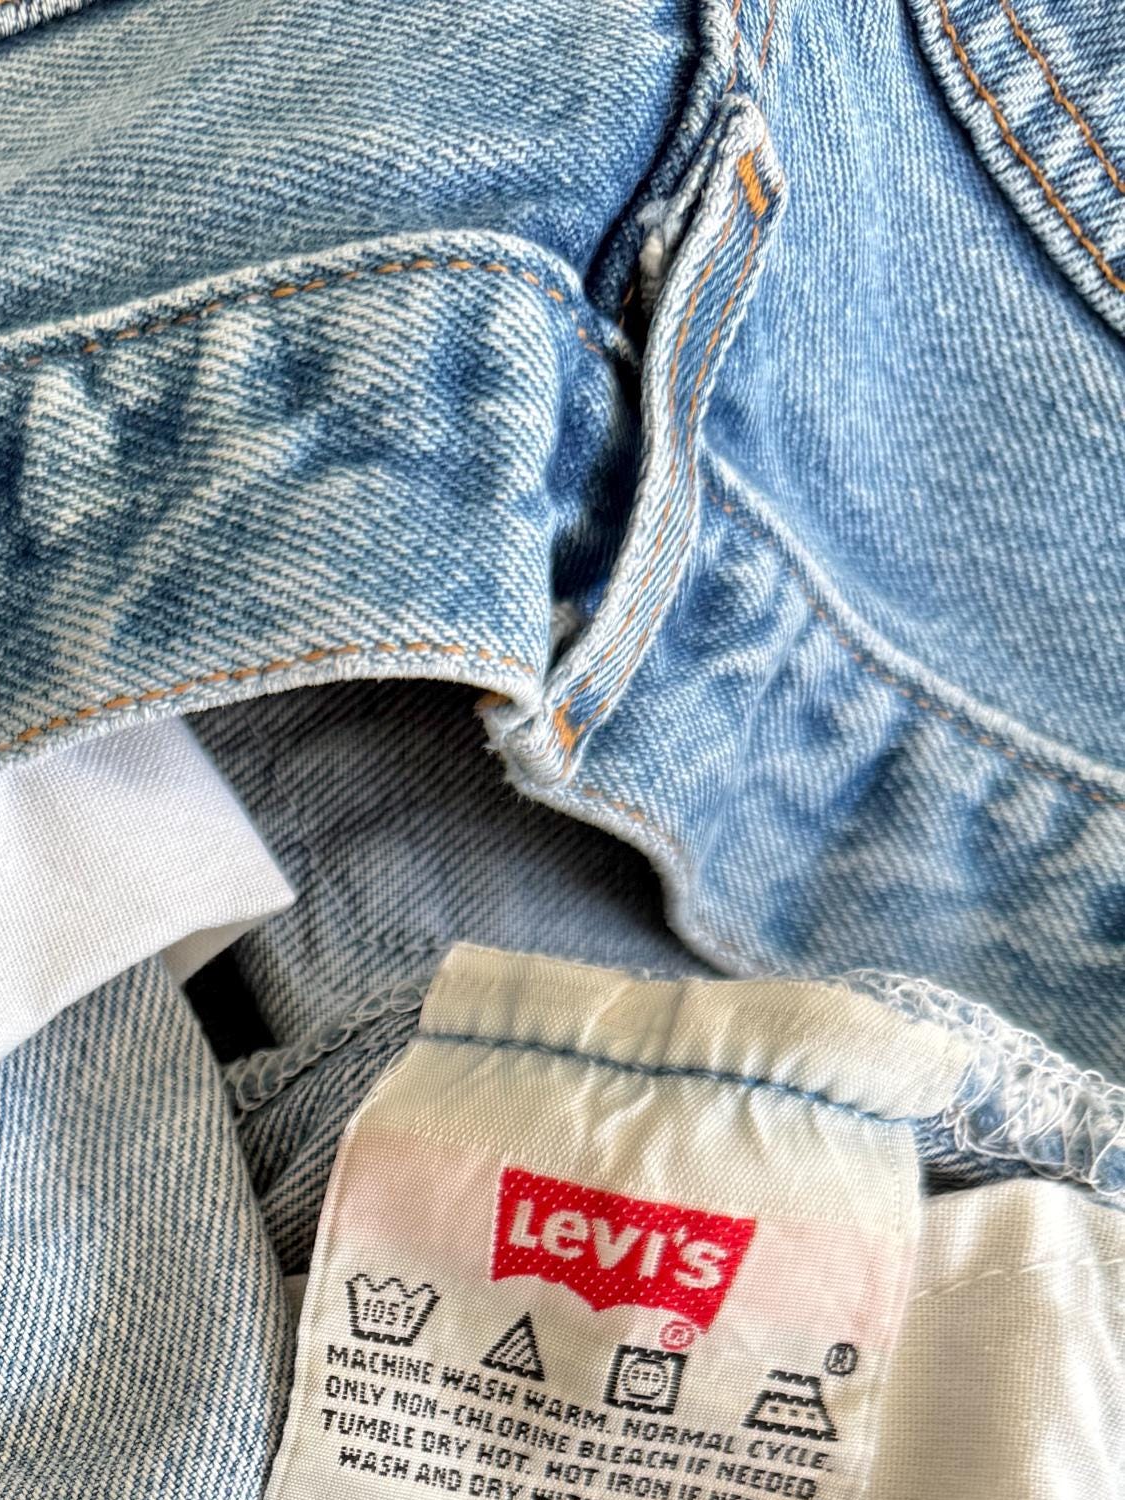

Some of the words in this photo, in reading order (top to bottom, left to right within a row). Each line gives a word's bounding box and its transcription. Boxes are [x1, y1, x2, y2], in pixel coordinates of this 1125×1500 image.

[321, 1409, 416, 1450] TUMBLE
[421, 1432, 471, 1460] DRY
[476, 1443, 532, 1475] HOT.
[544, 1461, 600, 1488] HOT
[605, 1472, 671, 1500] IRON
[325, 1375, 385, 1407] ONLY
[392, 1391, 571, 1453] NON-CHLORINE
[576, 1440, 679, 1471] BLEACH
[686, 1456, 710, 1476] IF
[327, 1345, 434, 1385] MACHINE
[441, 1366, 517, 1405] WASH
[524, 1390, 611, 1434] WARM.
[622, 1419, 733, 1455] NORMAL
[747, 1440, 833, 1472] CYCLE.
[338, 1446, 409, 1479] WASH
[415, 1463, 461, 1492] AND
